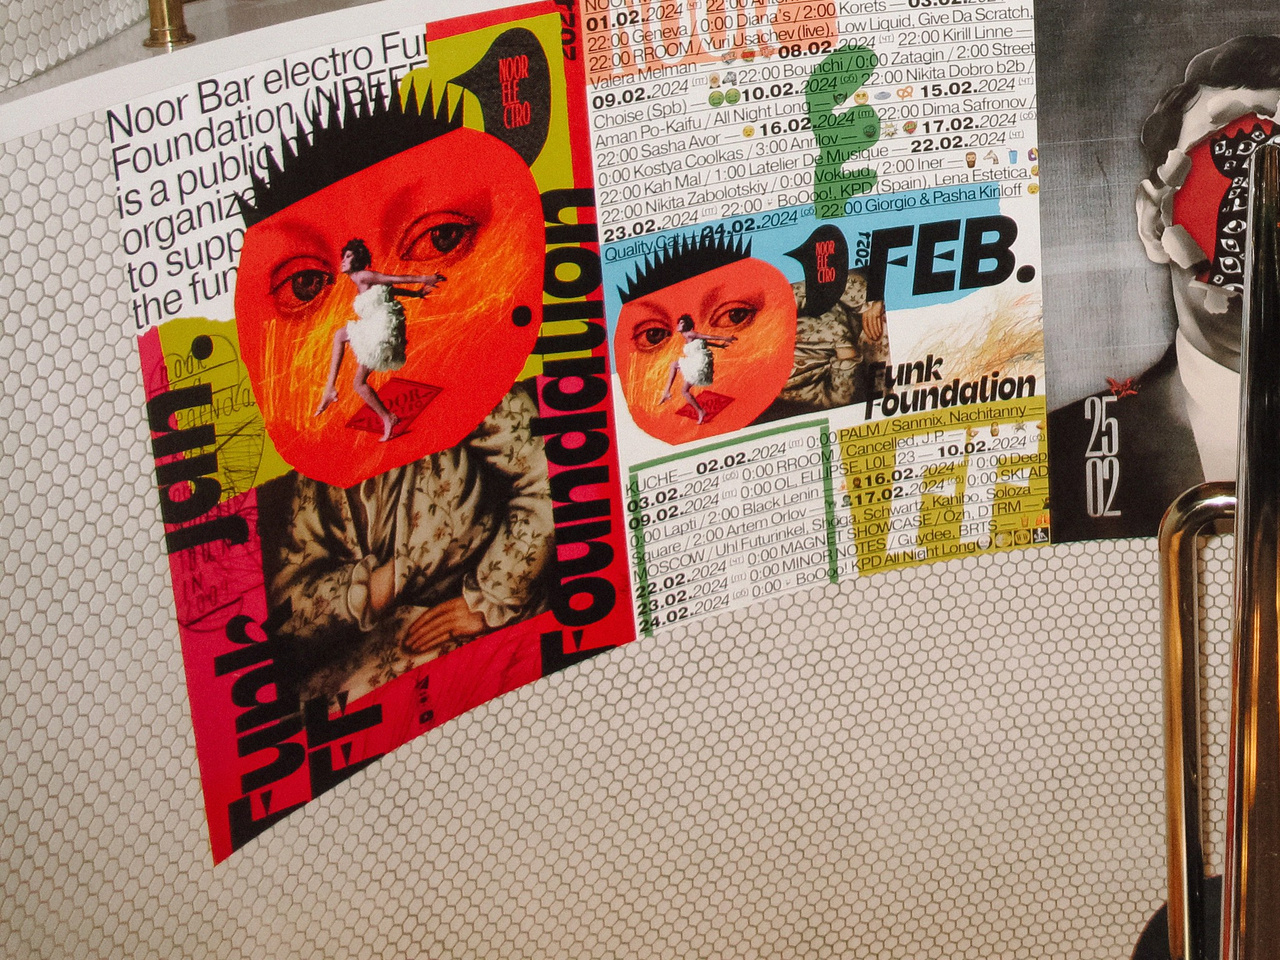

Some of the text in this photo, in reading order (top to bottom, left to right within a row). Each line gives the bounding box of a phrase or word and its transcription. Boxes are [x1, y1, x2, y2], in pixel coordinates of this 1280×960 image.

[586, 4, 684, 31] 01.02.2024
[587, 34, 629, 52] 22:00
[632, 25, 689, 44] Geneva
[700, 15, 733, 33] 0:00
[803, 3, 836, 19] 2:00
[589, 52, 631, 72] 22:00
[633, 42, 693, 64] RROOM
[733, 28, 794, 47] Usachev
[837, 20, 867, 34] Low
[918, 11, 949, 26] Give
[952, 9, 973, 23] Da
[499, 55, 529, 83] NOOR
[590, 25, 1013, 91] Valera Melman 08.02.2024 22:00 Kirill Linne
[592, 80, 689, 109] 09.02.2024
[738, 65, 781, 84] 22:00
[855, 52, 889, 69] 0:00
[891, 48, 945, 66] Zatagin
[957, 43, 990, 59] 2:00
[992, 40, 1036, 56] Street
[107, 93, 189, 144] Noor
[198, 74, 255, 115] Bar
[264, 45, 373, 95] electro
[112, 102, 295, 181] Foundation
[117, 186, 143, 219] is
[150, 179, 170, 206] a
[815, 240, 835, 256] NOOR
[866, 215, 1036, 302] FEB.
[128, 261, 158, 293] to
[133, 289, 183, 329] the
[865, 370, 1036, 420] Foundation
[696, 441, 787, 475] 02.02.2024
[806, 430, 837, 449] 0:00
[840, 421, 880, 441] PALM
[1084, 395, 1120, 458] 25
[626, 475, 720, 513] 03.02.2024
[742, 462, 774, 481] 0:00
[776, 448, 834, 474] RROOM
[1085, 457, 1123, 518] 02
